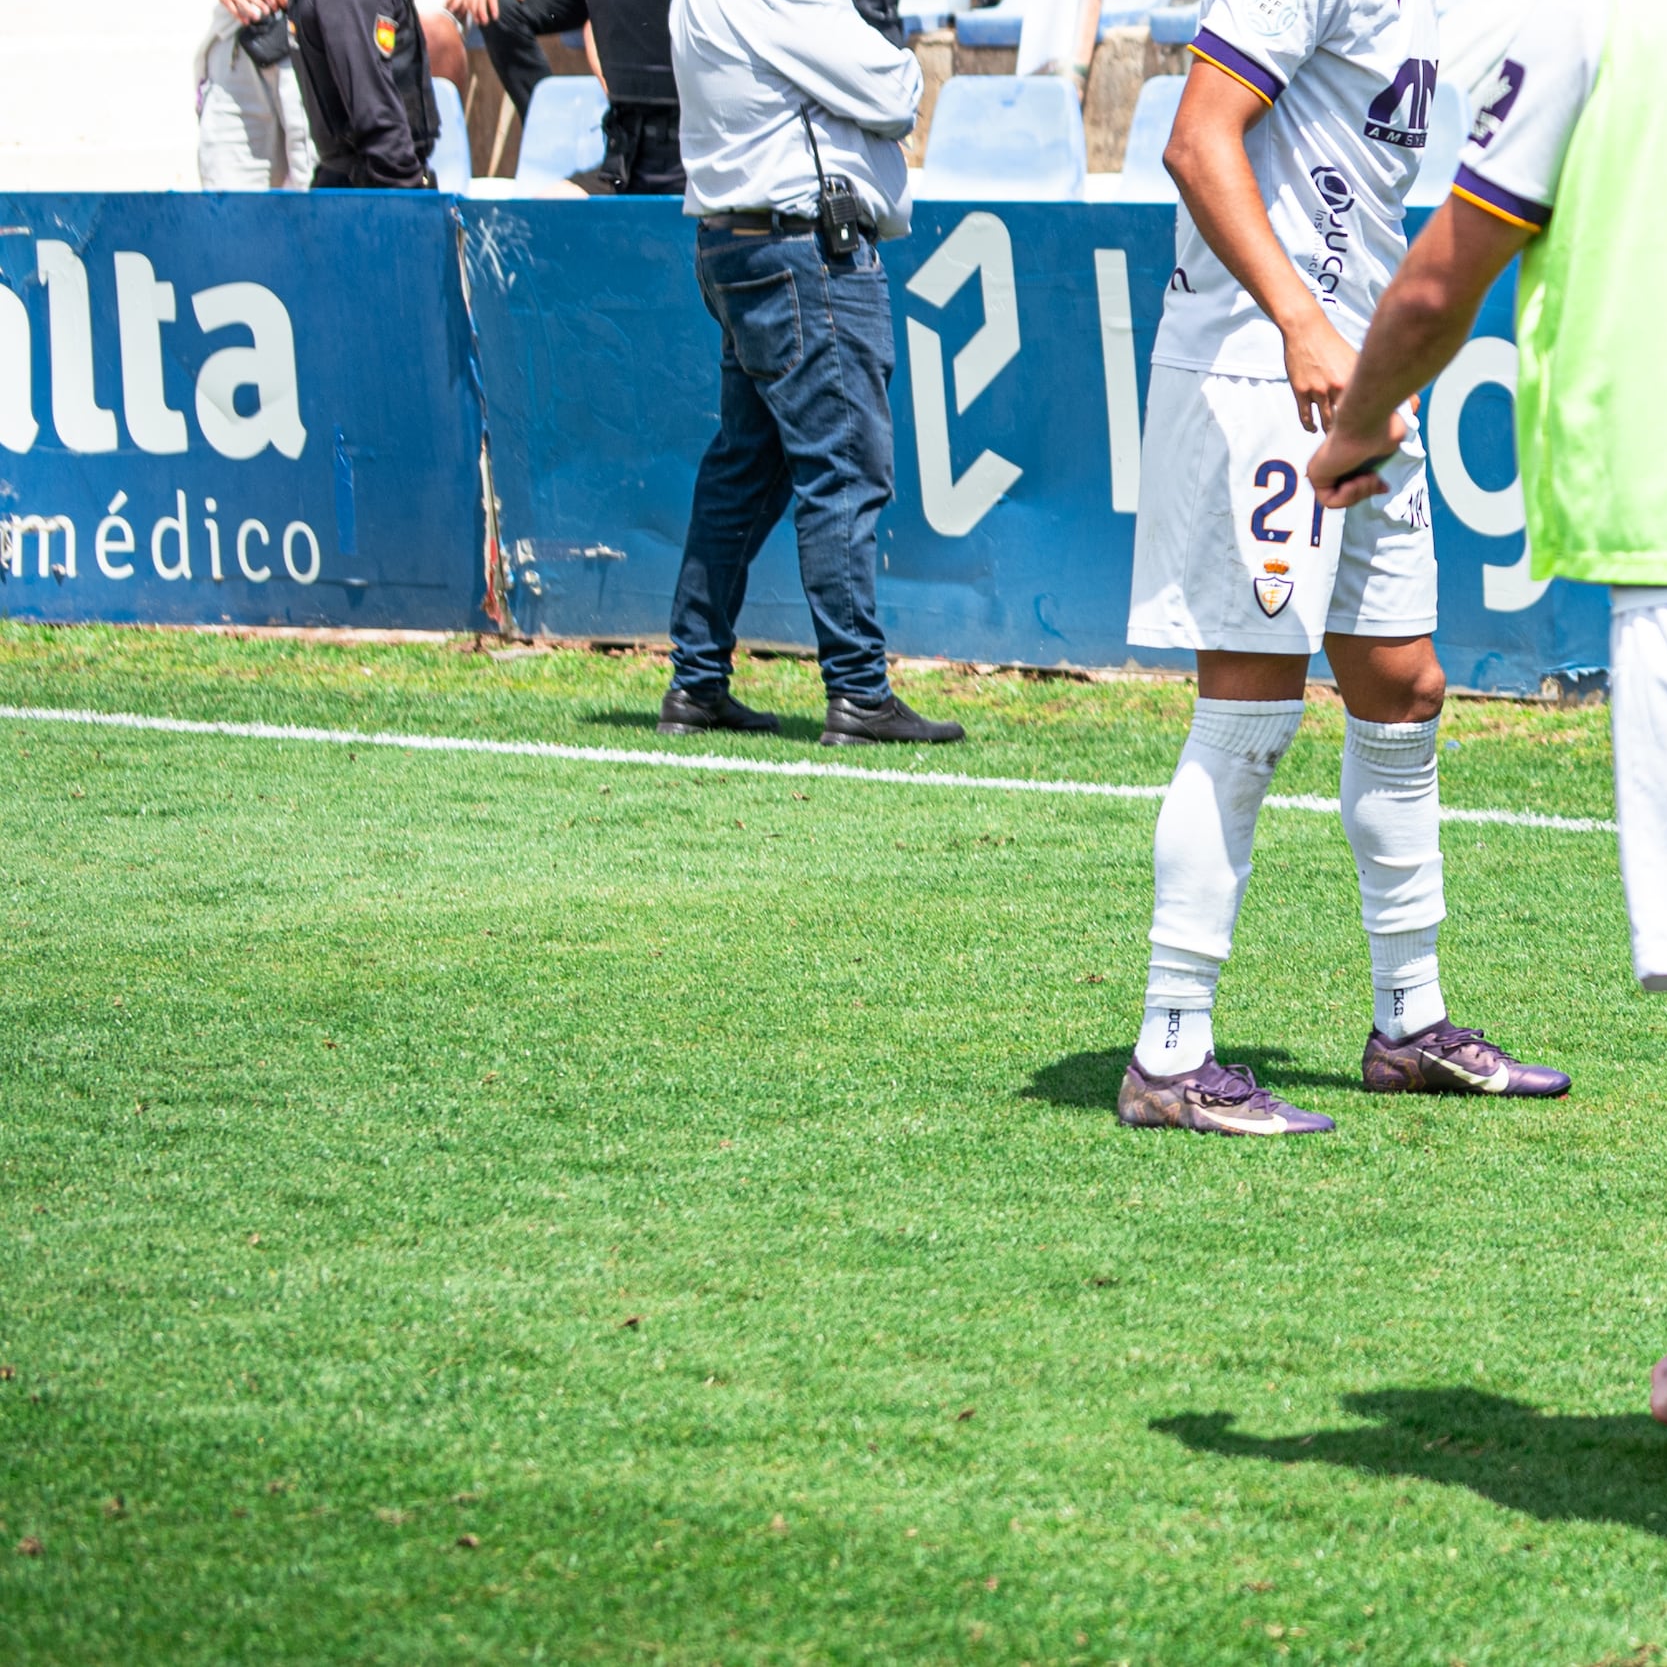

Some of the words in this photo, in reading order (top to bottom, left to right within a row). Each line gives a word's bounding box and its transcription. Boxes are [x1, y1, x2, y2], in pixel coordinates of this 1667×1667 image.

[1369, 128, 1425, 148] AMSY
[0, 488, 321, 585] médico
[1394, 988, 1405, 1017] CKS
